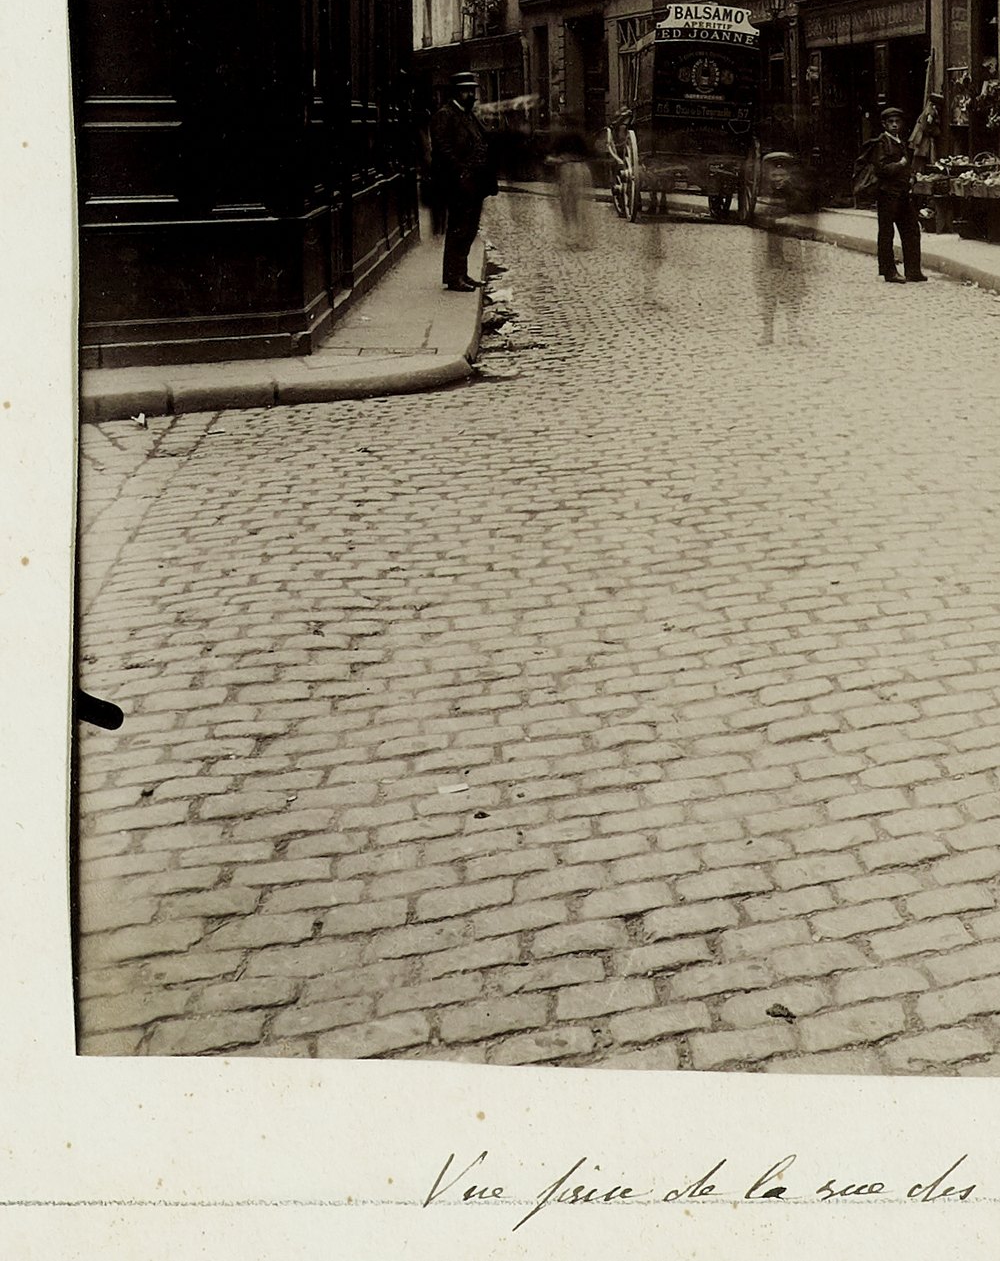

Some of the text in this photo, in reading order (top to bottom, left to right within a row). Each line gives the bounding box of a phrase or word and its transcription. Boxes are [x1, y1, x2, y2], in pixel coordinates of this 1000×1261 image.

[674, 5, 745, 24] BALSAMO
[683, 21, 733, 30] APERITIF
[661, 29, 755, 45] ED JOANNE
[423, 1150, 506, 1208] Vue
[662, 1158, 724, 1203] de
[744, 1153, 796, 1201] la
[815, 1180, 886, 1201] rue
[905, 1153, 984, 1203] des
